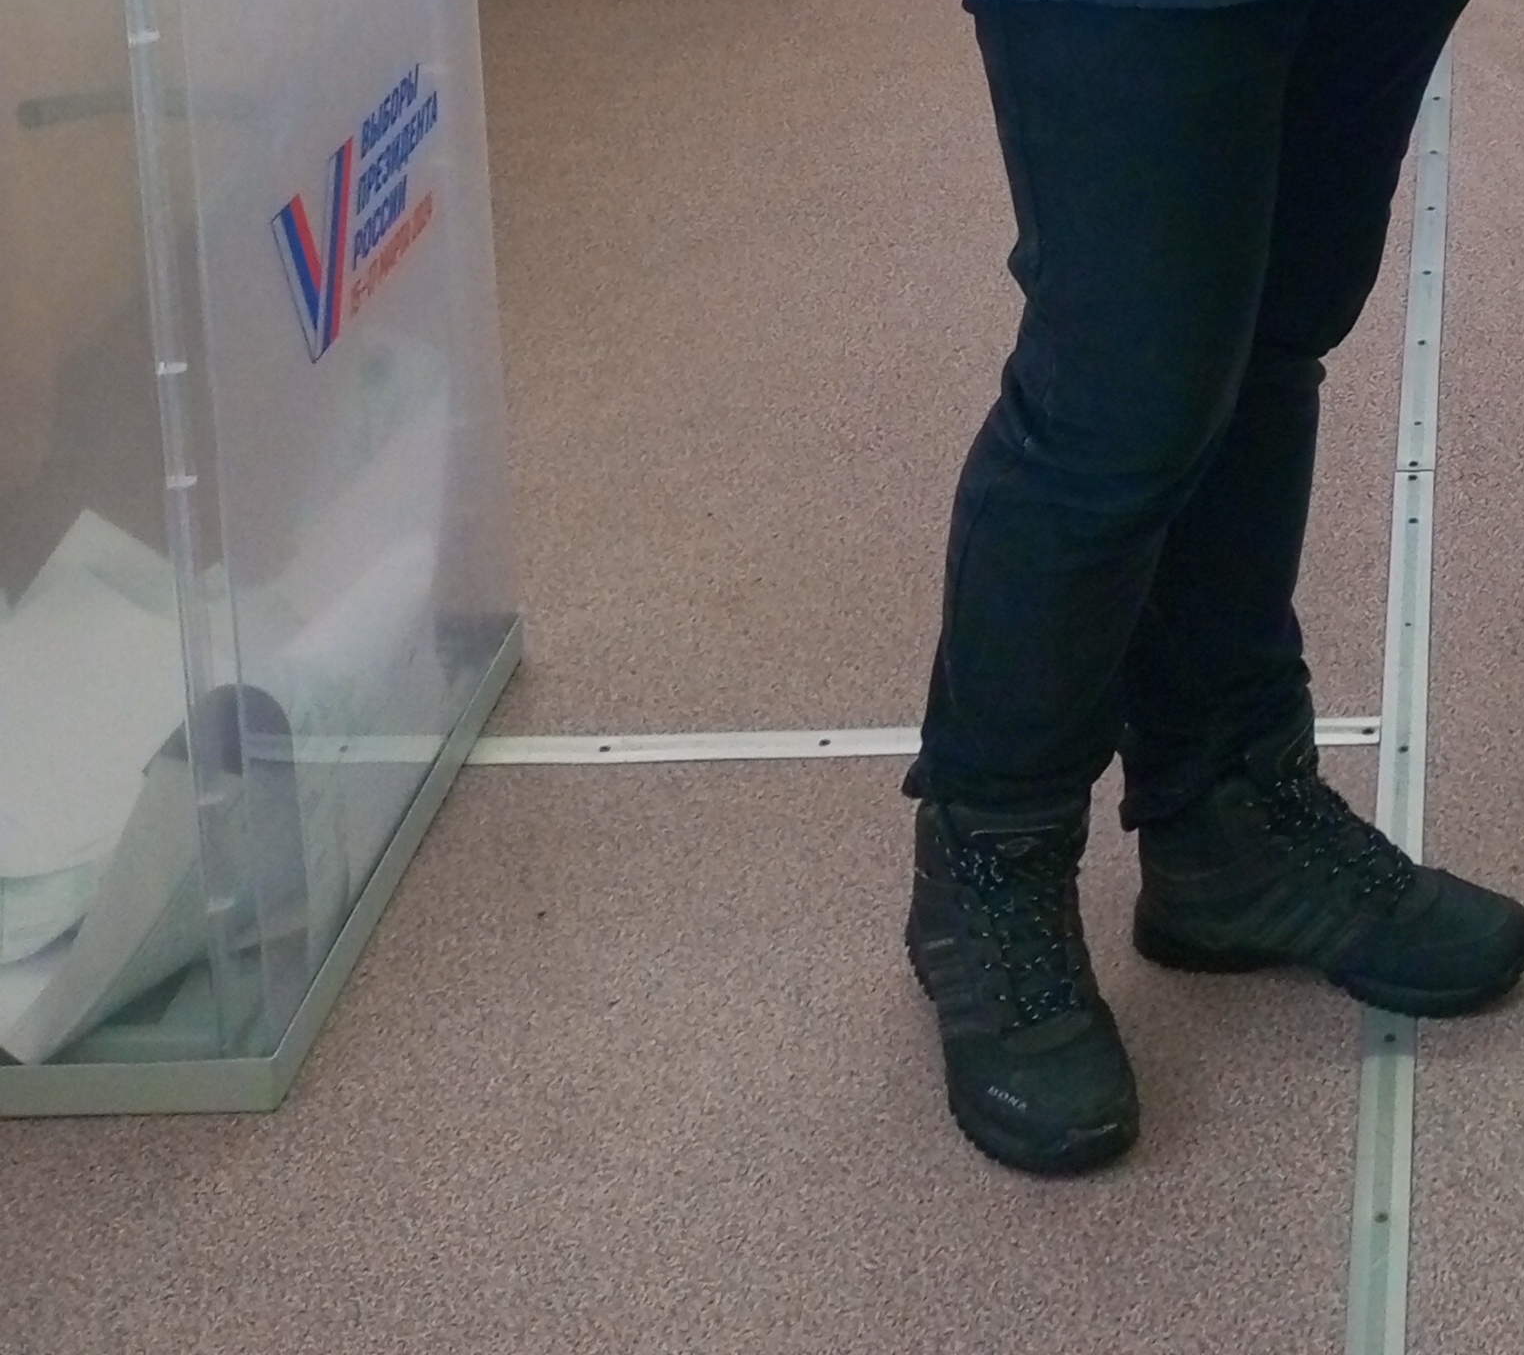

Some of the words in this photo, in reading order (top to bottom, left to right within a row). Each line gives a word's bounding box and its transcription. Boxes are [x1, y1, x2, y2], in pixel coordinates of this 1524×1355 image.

[356, 91, 438, 216] ПРЕЗИДЕНТА
[360, 63, 419, 159] ВЫБОРЫ
[353, 174, 408, 272] РОССИИ
